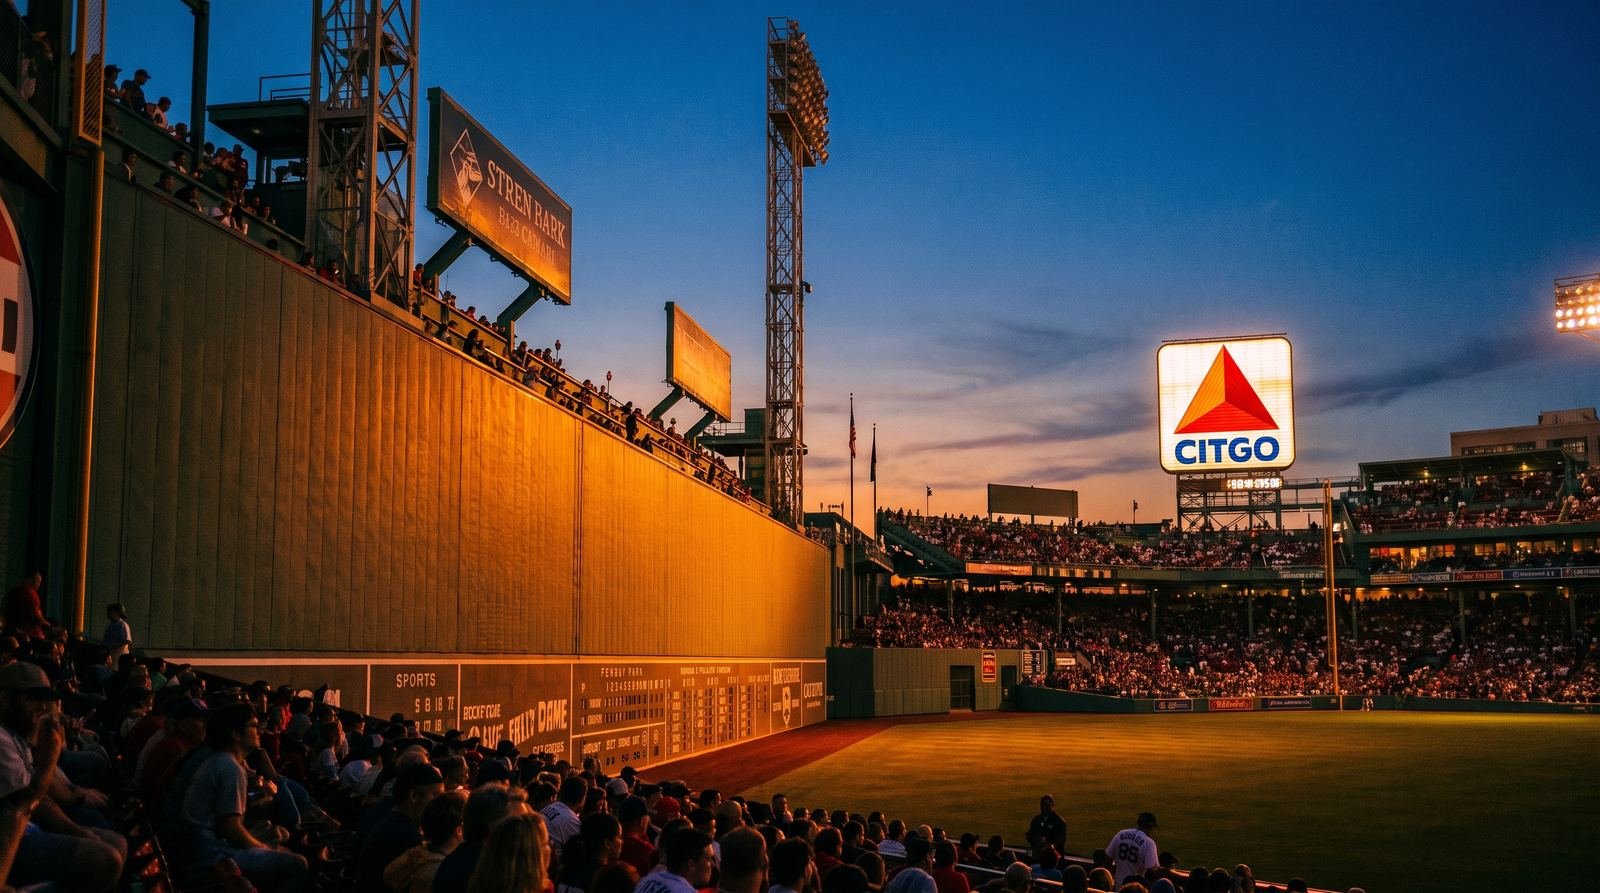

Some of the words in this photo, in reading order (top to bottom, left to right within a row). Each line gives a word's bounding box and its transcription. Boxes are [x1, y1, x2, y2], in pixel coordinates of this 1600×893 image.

[487, 159, 532, 220] STREN
[534, 201, 566, 249] BARK
[1174, 436, 1280, 465] CITGO
[396, 672, 436, 688] SPORTS
[537, 699, 568, 733] DAME
[1119, 843, 1139, 863] 85
